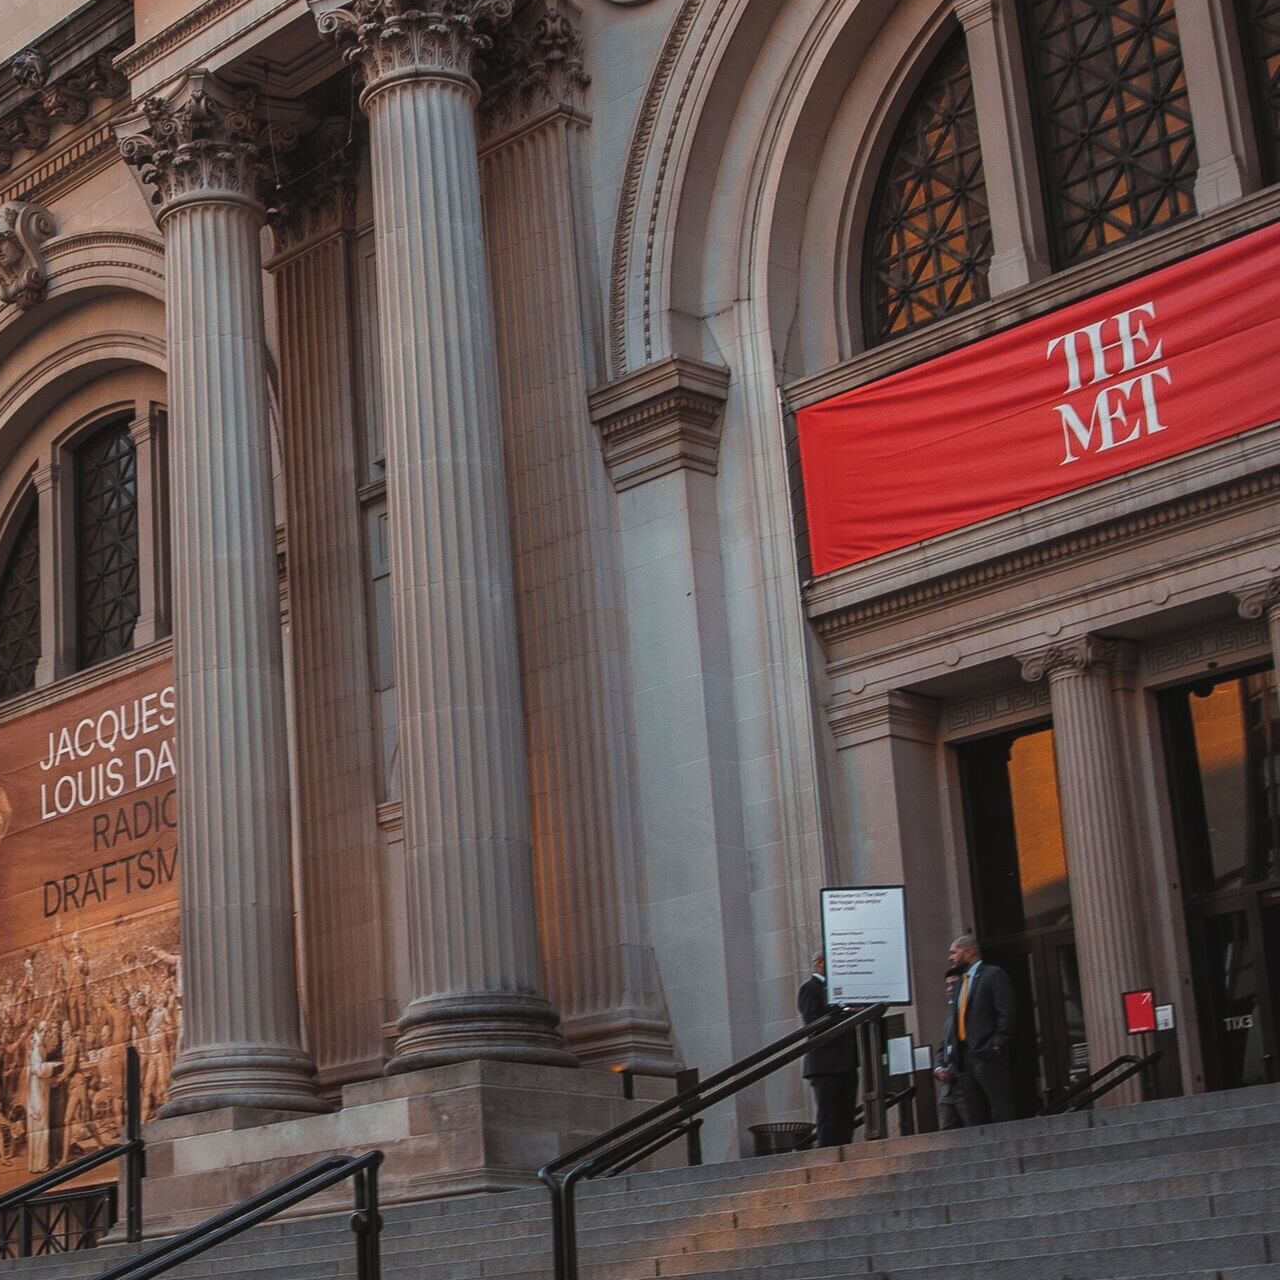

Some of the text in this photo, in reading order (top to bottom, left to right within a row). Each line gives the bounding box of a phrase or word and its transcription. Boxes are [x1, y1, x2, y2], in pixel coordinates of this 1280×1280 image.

[1046, 301, 1163, 395] THE
[1052, 366, 1173, 466] MET
[39, 686, 176, 770] JACQUES
[41, 737, 176, 820] LOUIS DA
